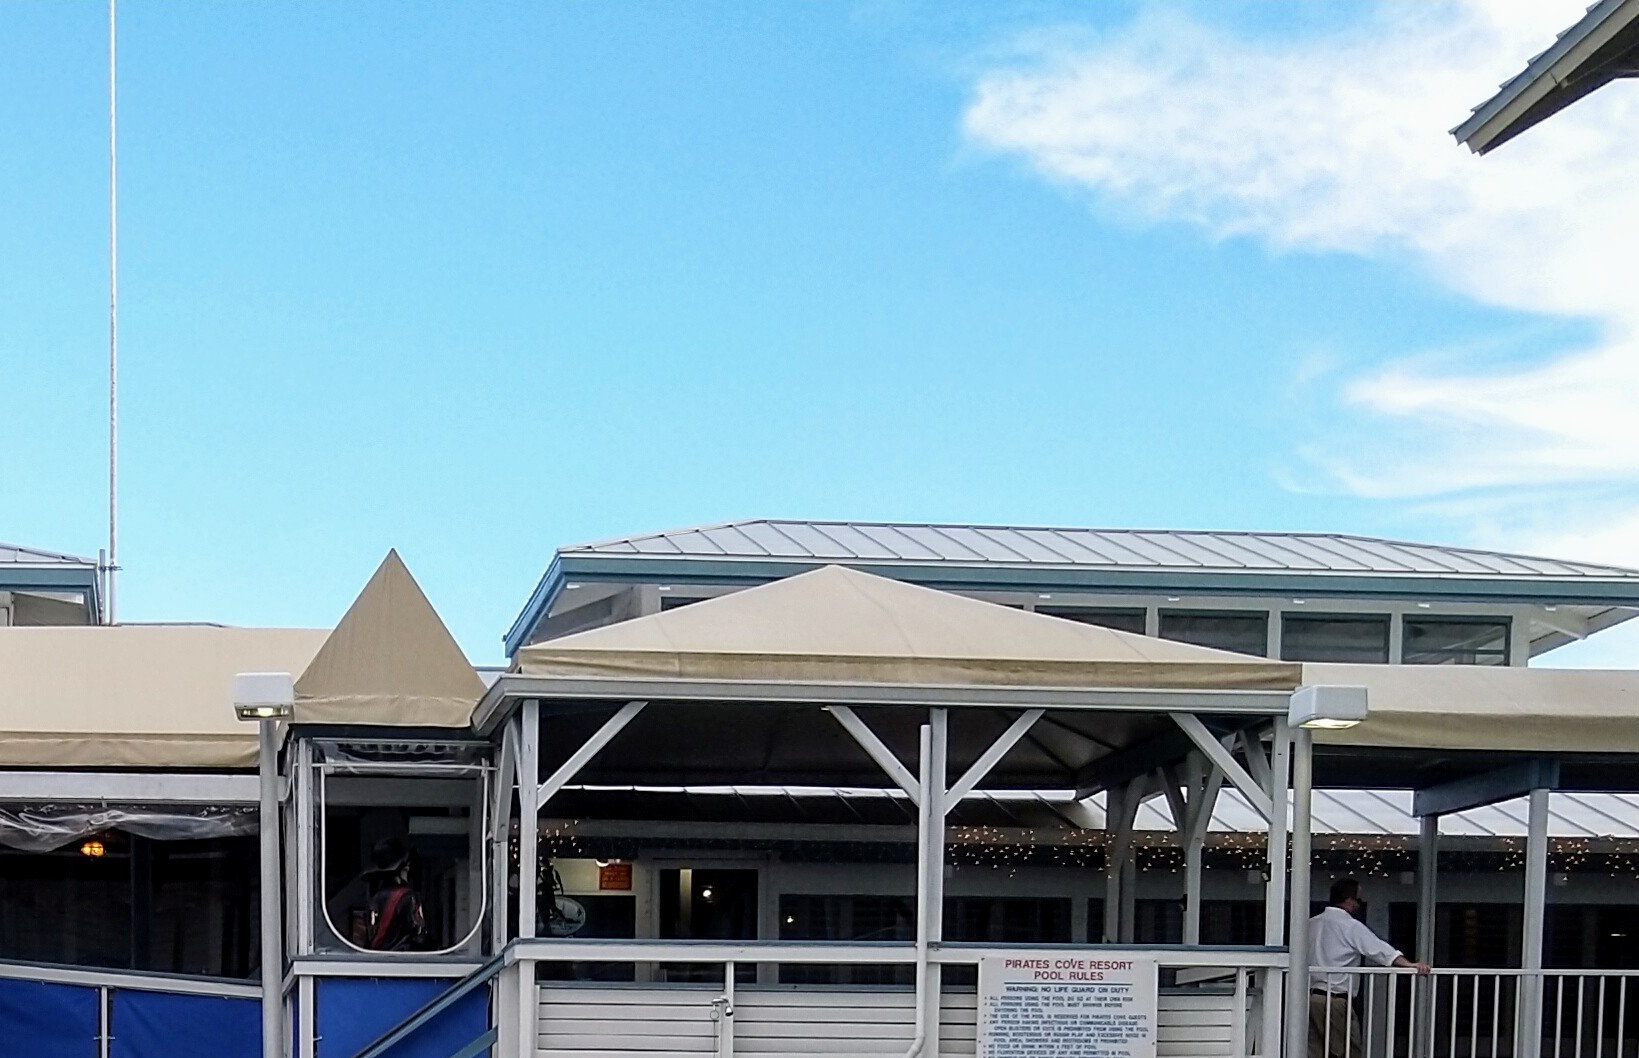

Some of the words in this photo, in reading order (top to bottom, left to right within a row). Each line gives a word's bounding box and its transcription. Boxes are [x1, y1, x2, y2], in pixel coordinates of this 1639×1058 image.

[1005, 960, 1049, 969] PIRATES
[1055, 960, 1084, 969] COVE
[1090, 961, 1133, 970] RESORT
[1034, 971, 1064, 980] POOL
[1069, 972, 1104, 981] RULES
